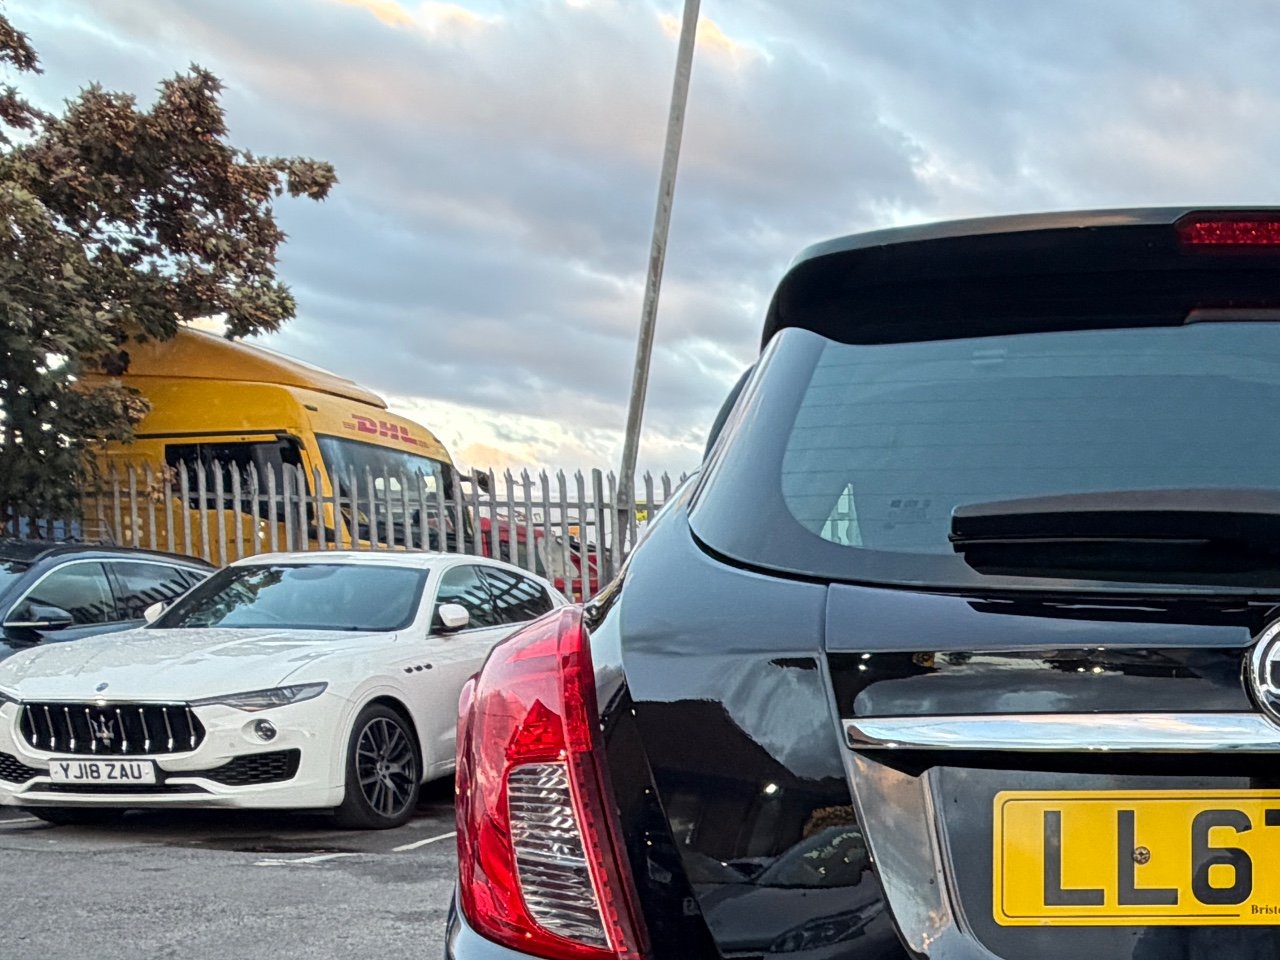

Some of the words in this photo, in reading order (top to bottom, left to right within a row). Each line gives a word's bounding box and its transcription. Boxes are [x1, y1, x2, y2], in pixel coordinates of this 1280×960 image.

[351, 413, 419, 445] DHL
[59, 762, 101, 779] YJ18
[104, 763, 142, 780] ZAU
